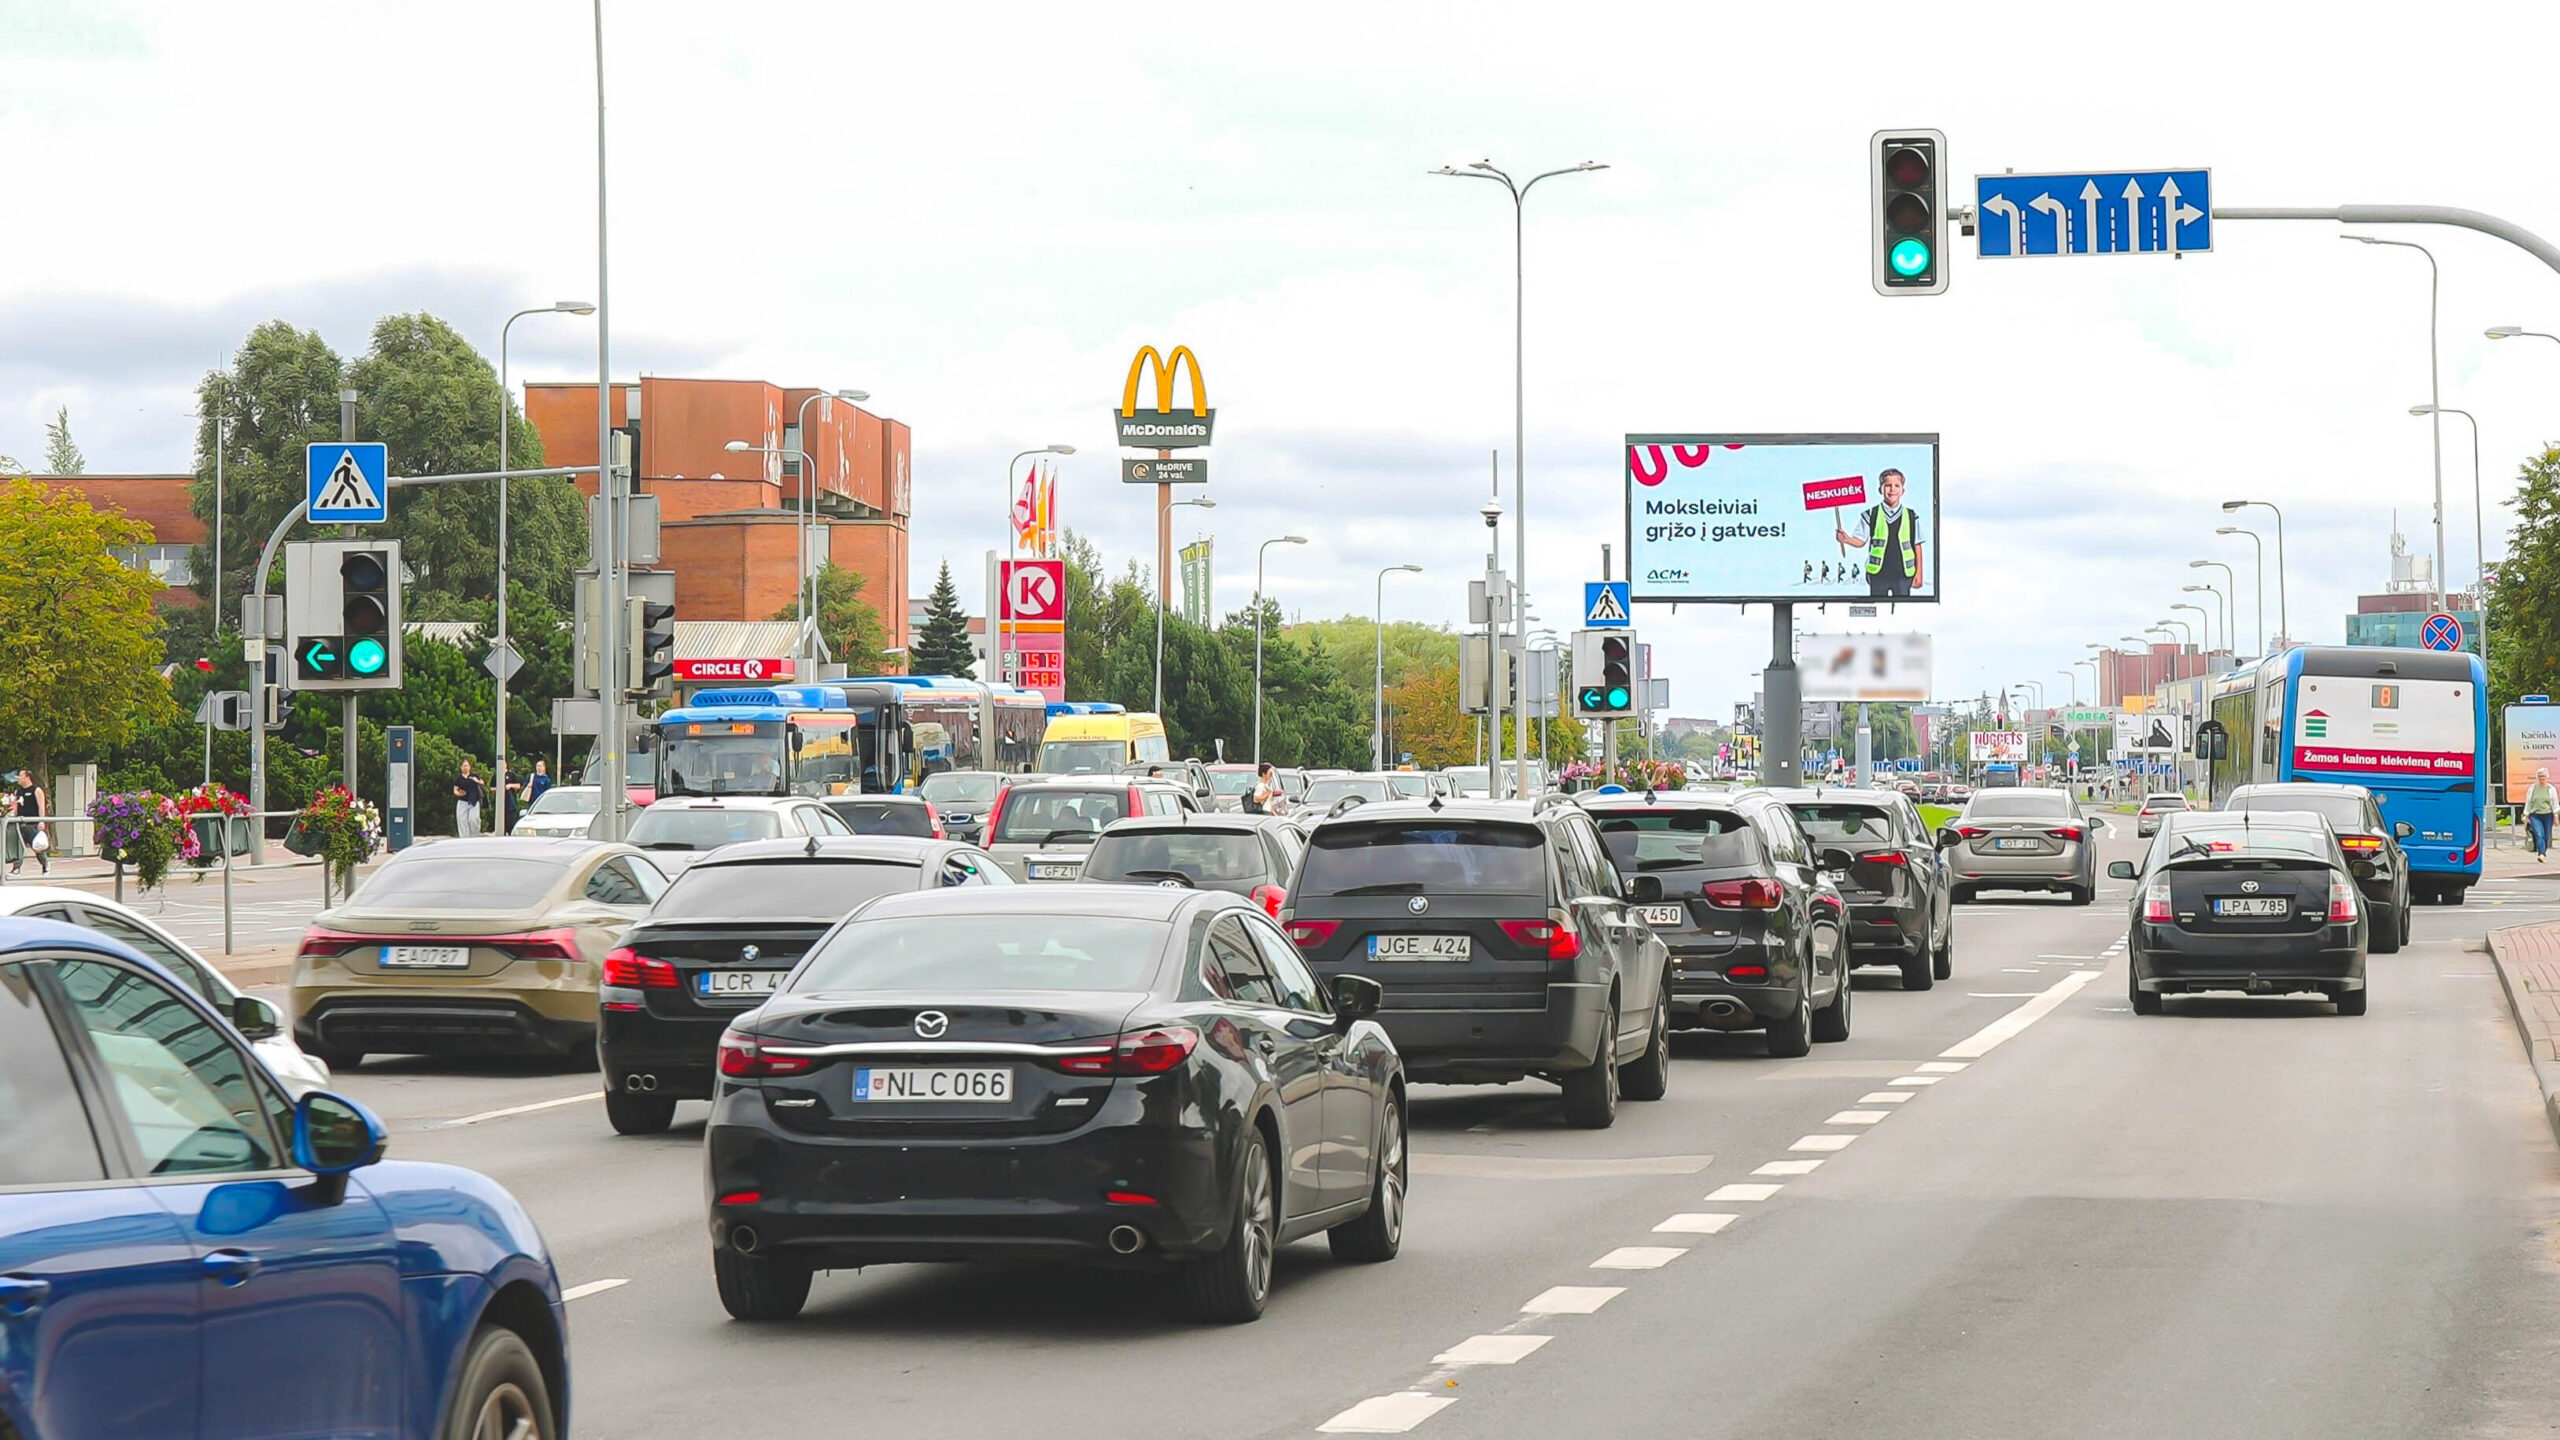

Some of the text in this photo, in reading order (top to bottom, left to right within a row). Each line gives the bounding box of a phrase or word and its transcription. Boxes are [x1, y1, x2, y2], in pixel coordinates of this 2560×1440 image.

[1122, 424, 1207, 436] McDonald's
[1156, 463, 1193, 471] McDRIVE
[1806, 484, 1863, 501] NESKUBĖK
[1646, 499, 1758, 515] Moksleiviai
[1646, 522, 1786, 542] grįžo į gatves!
[1647, 569, 1682, 579] ACM
[1021, 577, 1052, 611] K
[691, 664, 741, 675] CIRCLE
[2380, 687, 2391, 707] 8
[2304, 750, 2463, 770] Žemos kainos kiekvieną dieną
[1044, 866, 1081, 877] GFZ11
[2222, 900, 2285, 912] LPA 785
[1650, 908, 1678, 921] 450
[1380, 937, 1467, 954] JGE 424
[712, 973, 753, 991] LCR
[888, 1072, 1005, 1097] NLC066
